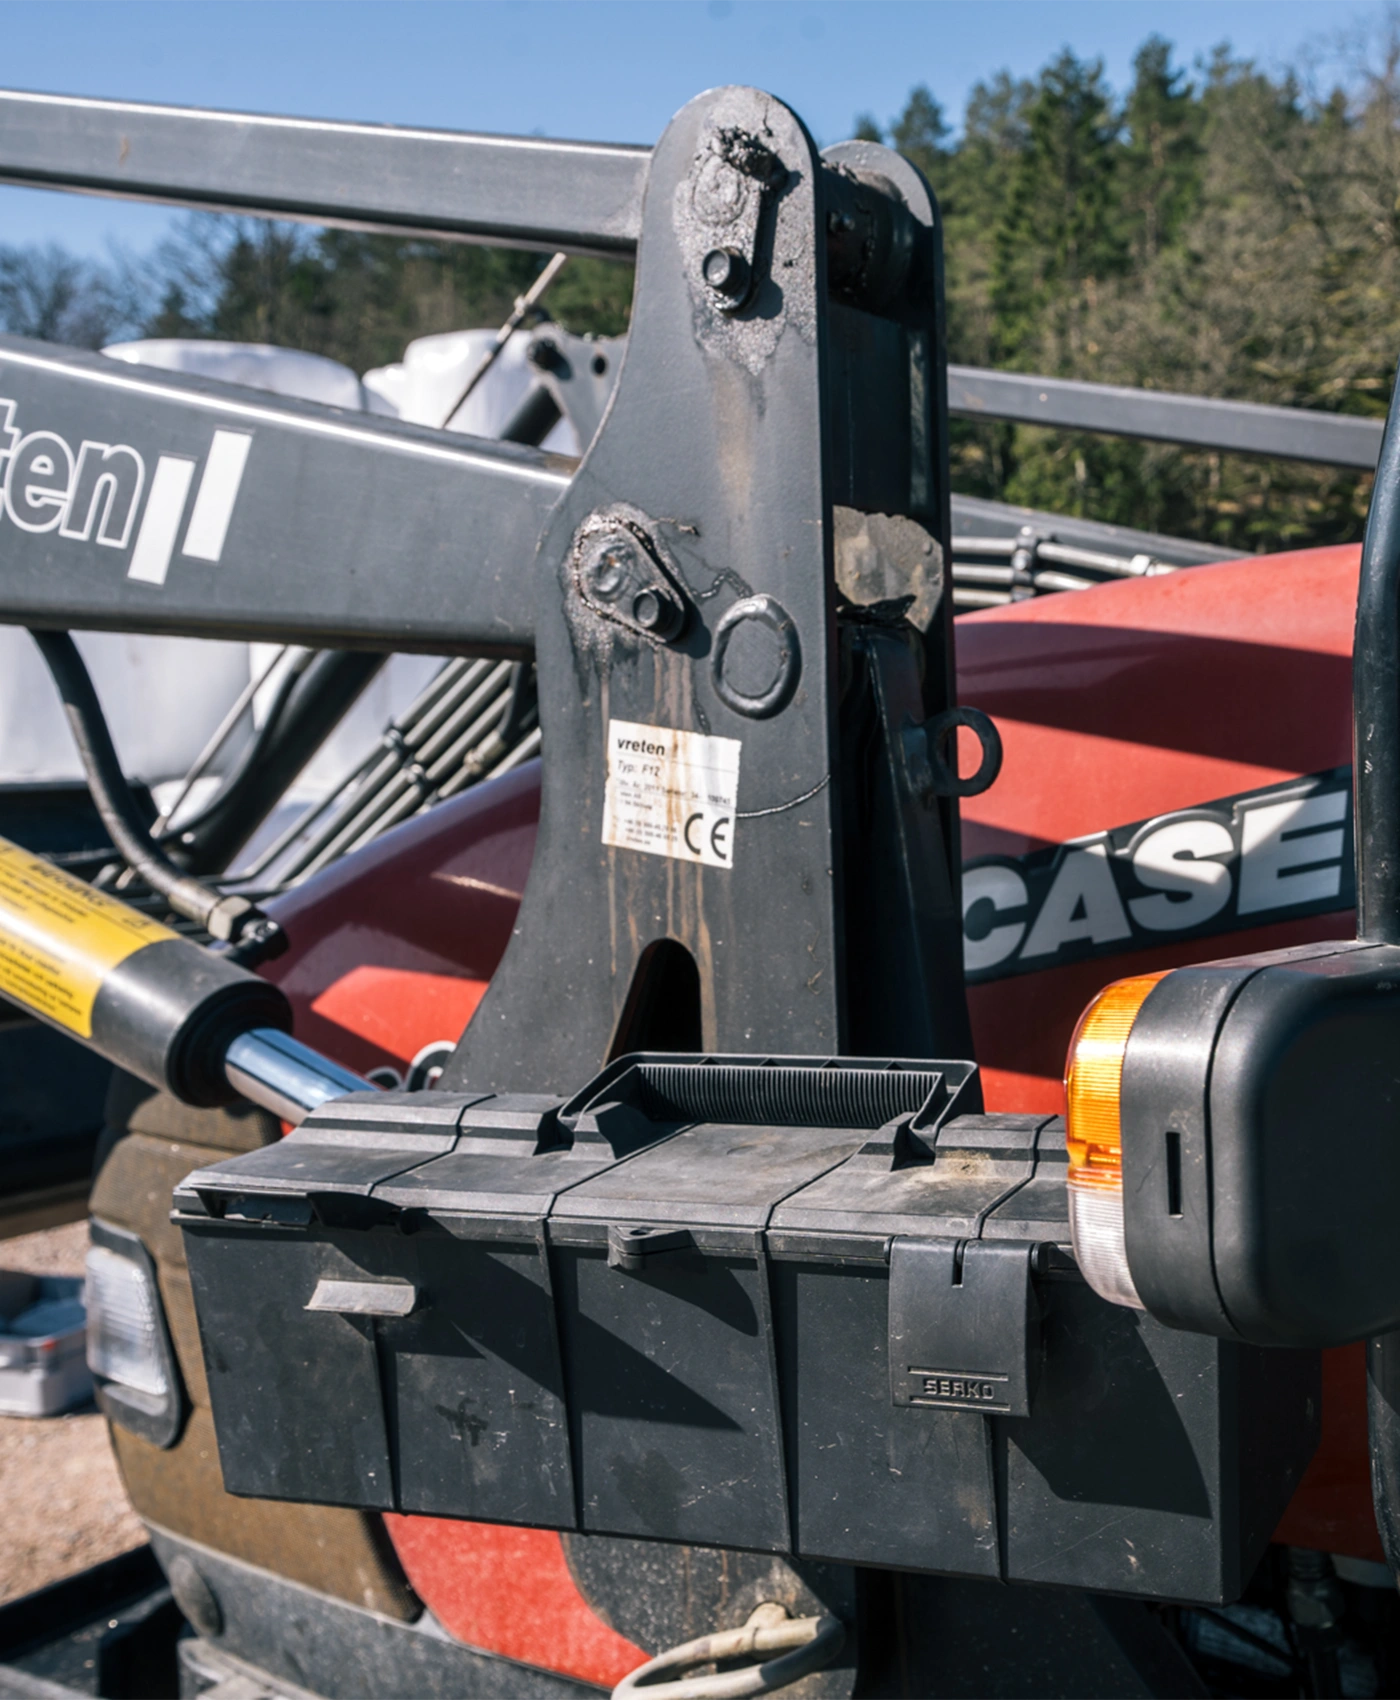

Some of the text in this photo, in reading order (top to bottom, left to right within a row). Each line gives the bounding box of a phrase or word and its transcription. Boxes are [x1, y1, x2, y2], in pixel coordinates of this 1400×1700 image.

[617, 738, 665, 756] vreten
[684, 812, 730, 860] CE
[962, 789, 1349, 972] CASE
[923, 1378, 996, 1400] SERKO
